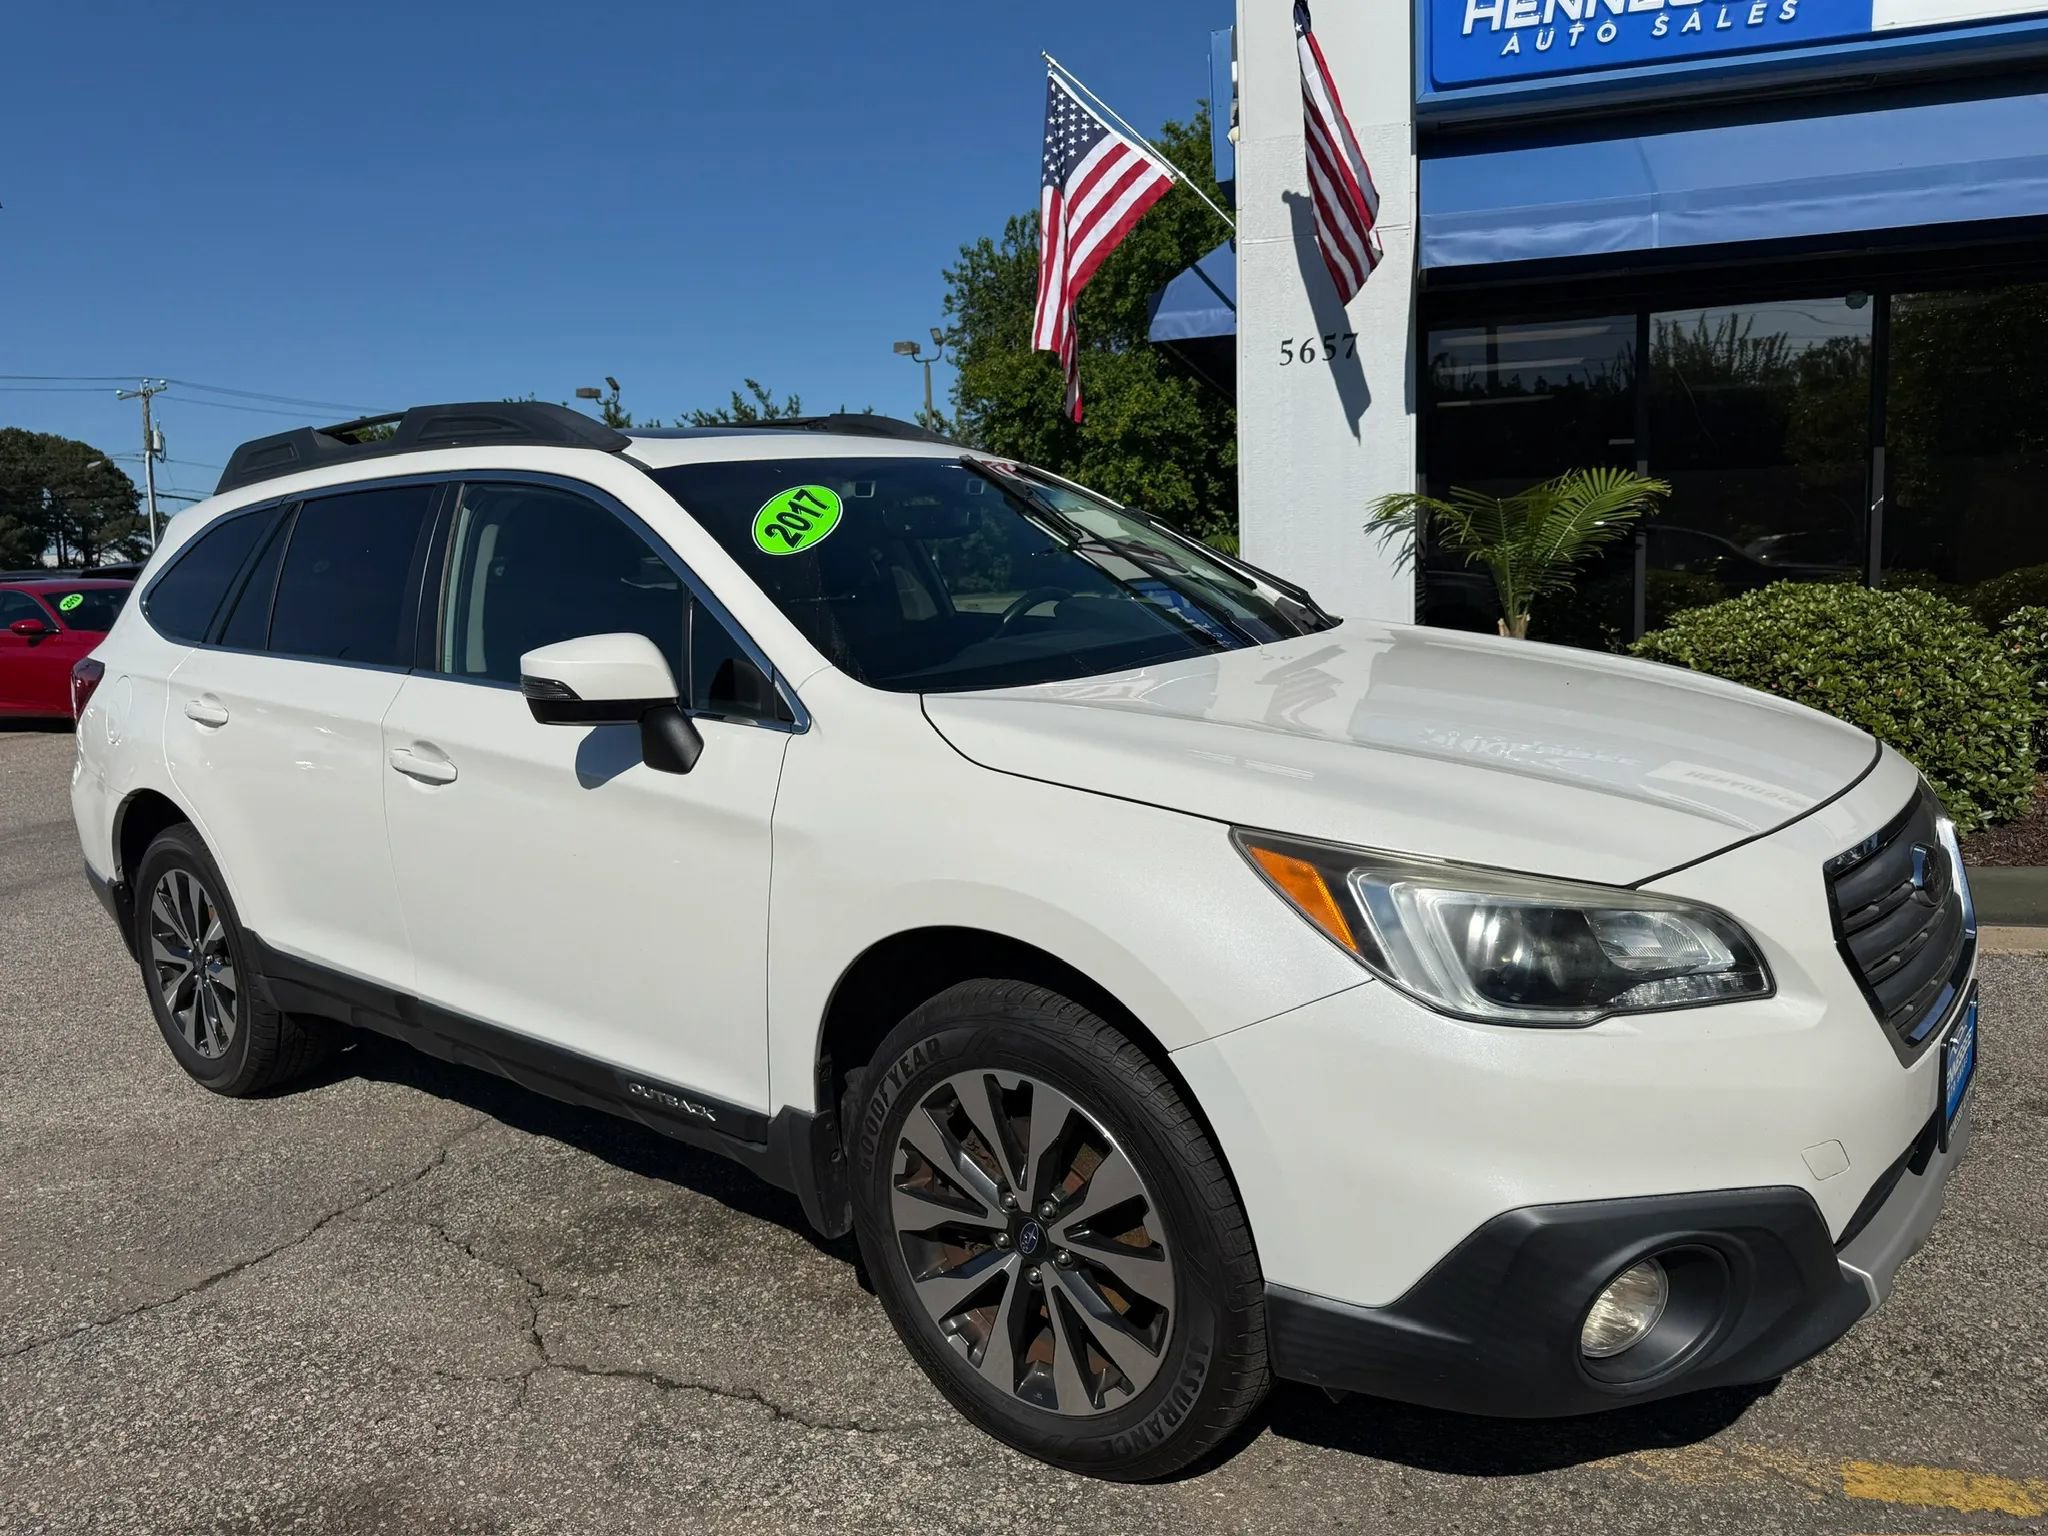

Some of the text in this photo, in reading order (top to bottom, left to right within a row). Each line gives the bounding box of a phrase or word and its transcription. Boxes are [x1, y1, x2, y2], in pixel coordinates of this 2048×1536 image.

[1501, 0, 1798, 55] AUTO SALES
[1279, 333, 1359, 366] 5657
[764, 488, 828, 549] 2017
[628, 1082, 717, 1122] OUTBACK
[861, 1037, 944, 1175] GOODYEAR
[1100, 1337, 1209, 1456] ASSURANCE
